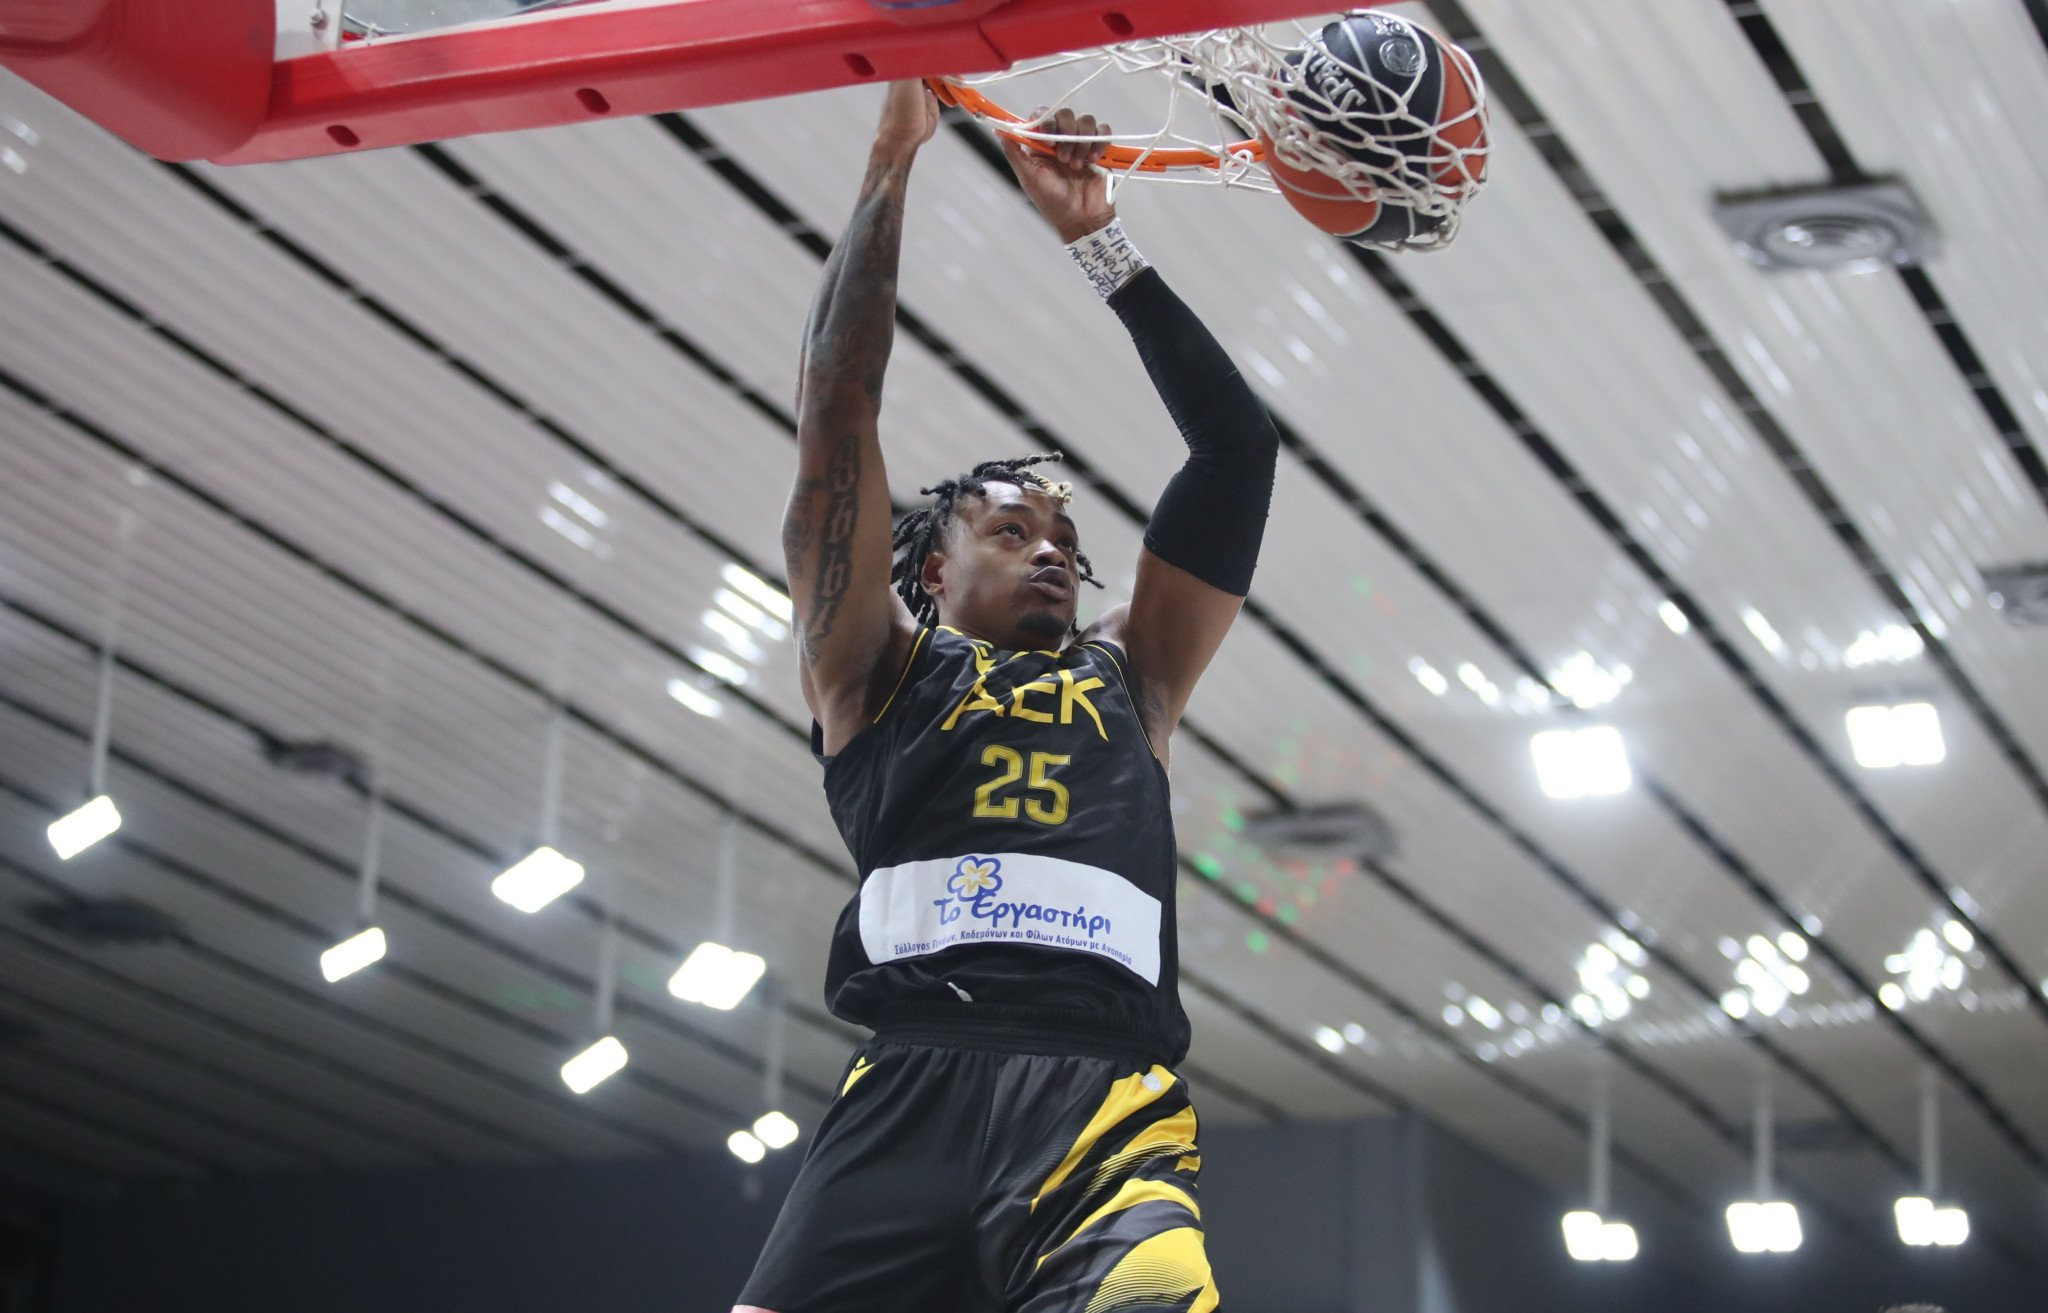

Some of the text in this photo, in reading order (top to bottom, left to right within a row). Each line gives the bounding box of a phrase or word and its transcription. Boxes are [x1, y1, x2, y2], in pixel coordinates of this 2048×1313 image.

[973, 744, 1071, 826] 25
[971, 892, 1112, 938] Εργαστήρι
[895, 942, 930, 955] Σύλλογος
[960, 929, 1008, 941] Κηδεμόνων
[1010, 931, 1023, 939] και
[1026, 930, 1053, 942] Φίλων
[1055, 934, 1088, 948] Ατόμων
[1089, 941, 1100, 951] με
